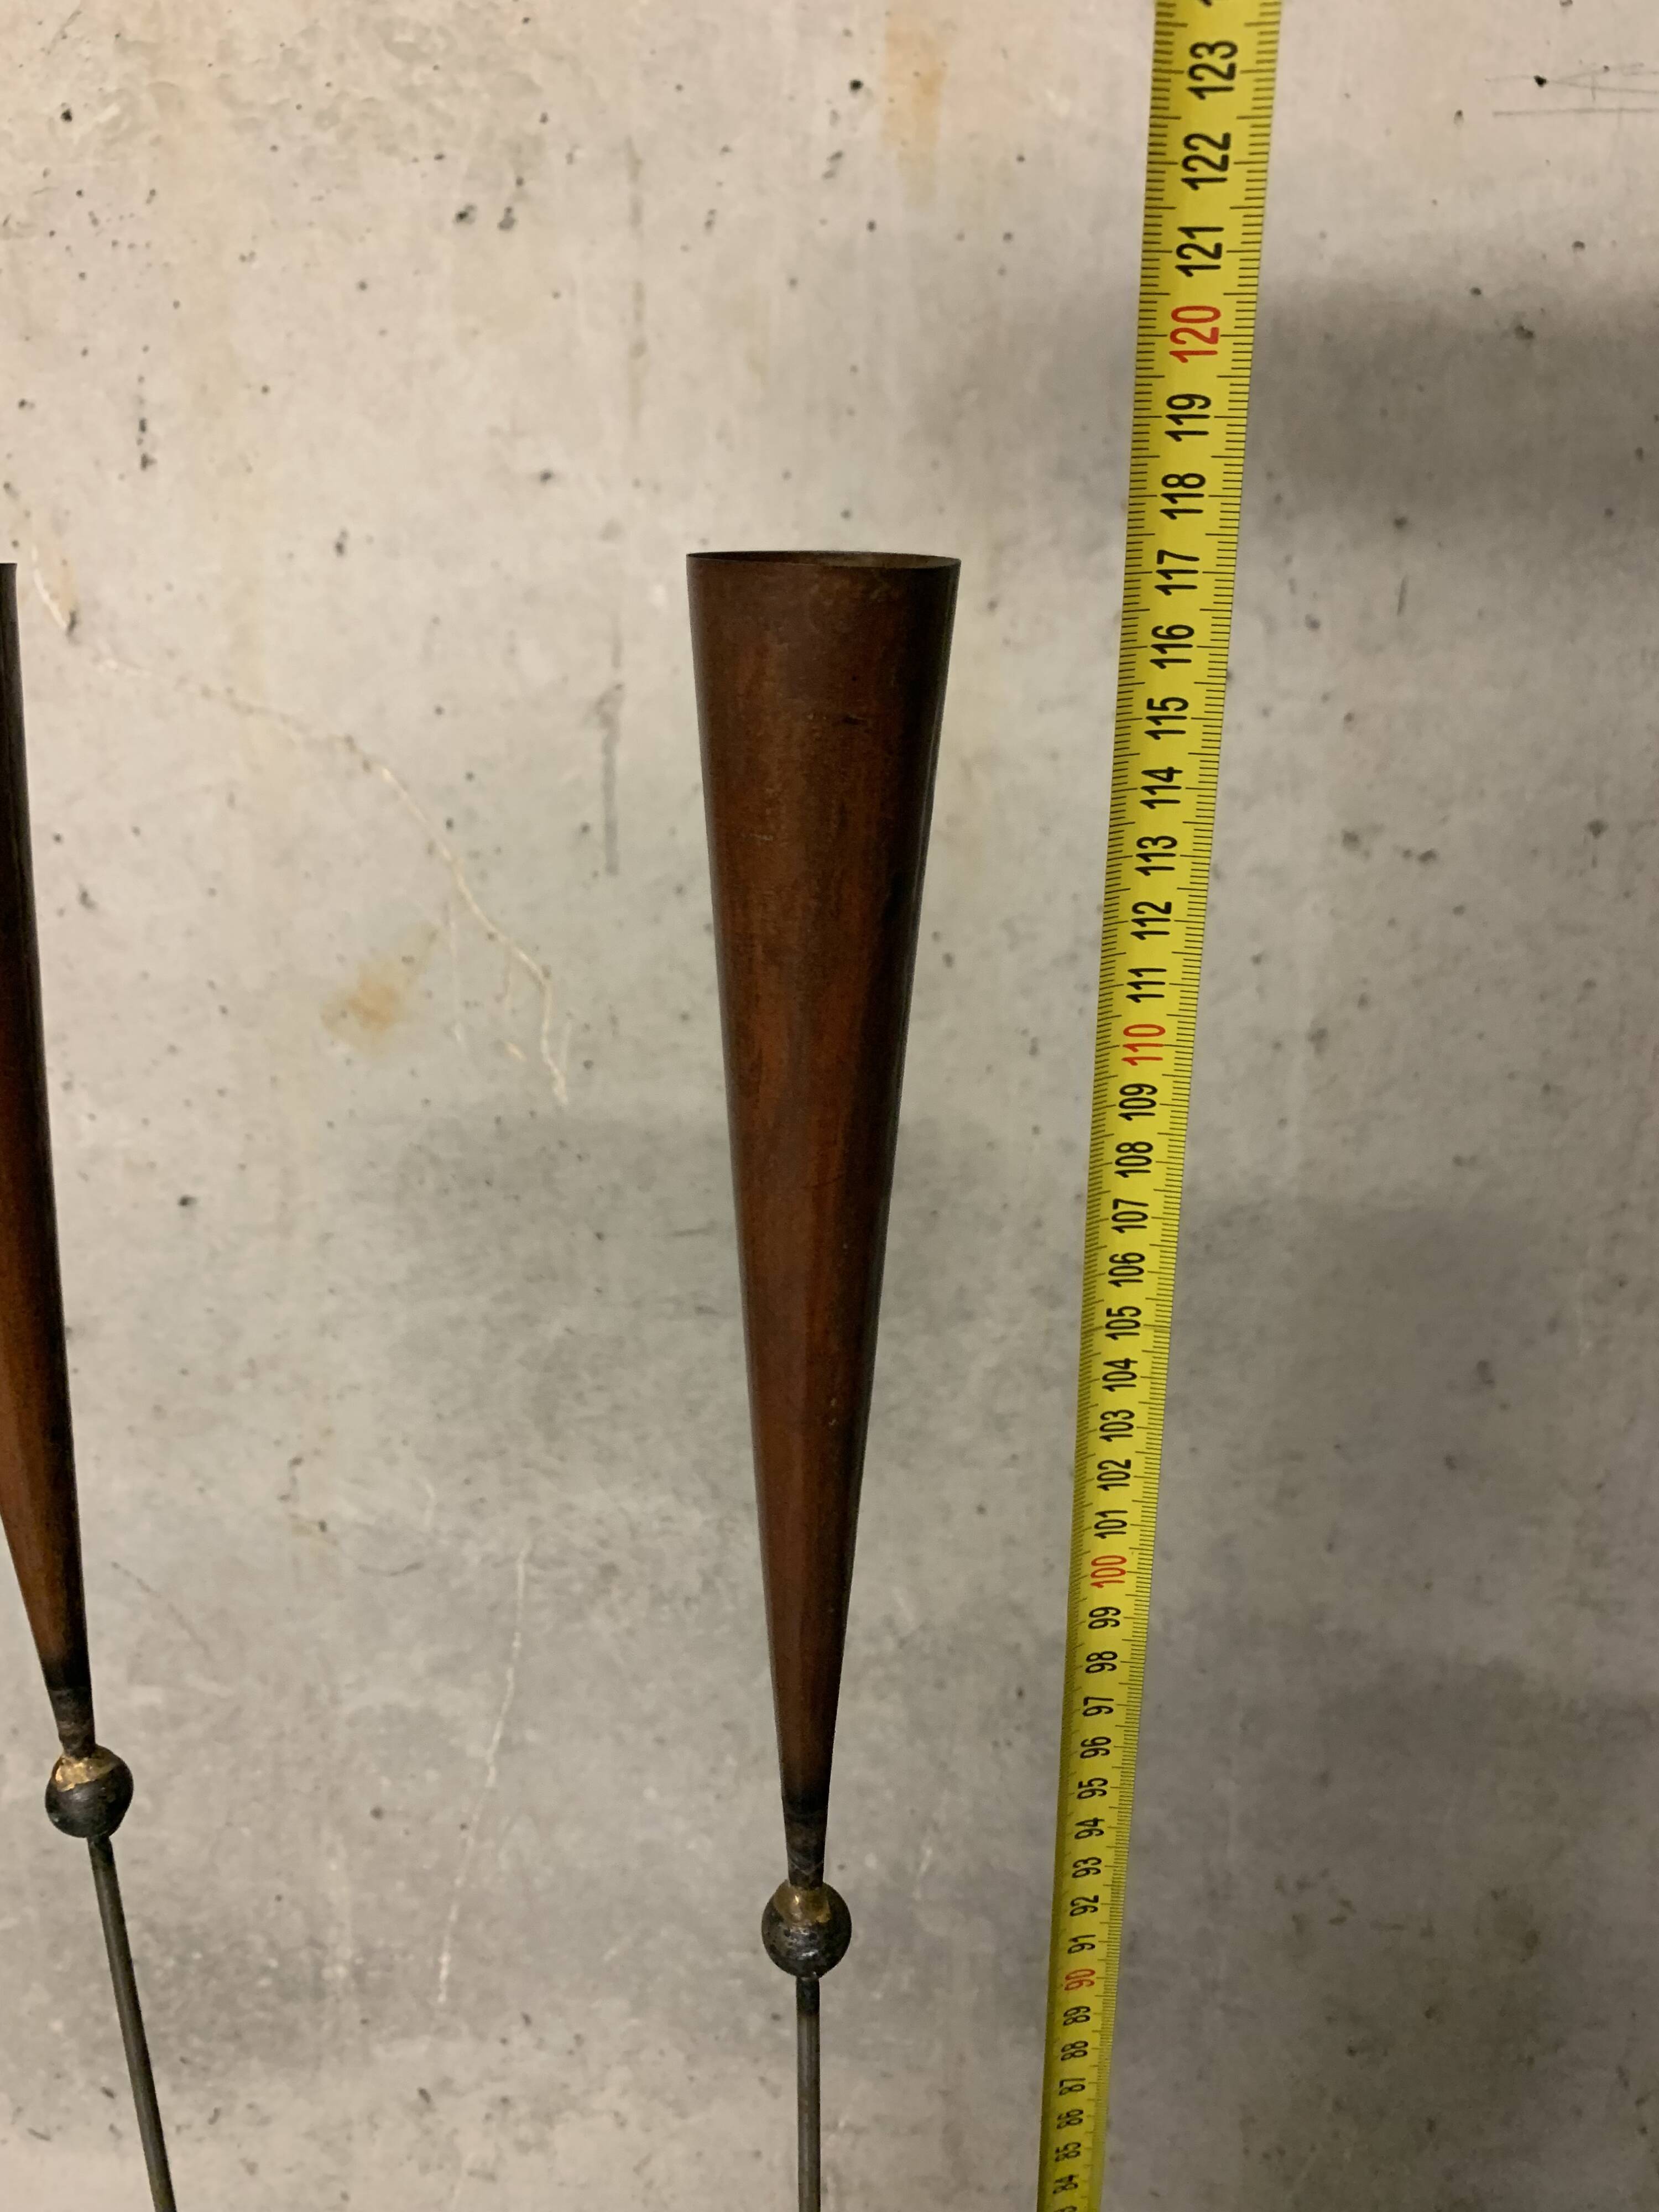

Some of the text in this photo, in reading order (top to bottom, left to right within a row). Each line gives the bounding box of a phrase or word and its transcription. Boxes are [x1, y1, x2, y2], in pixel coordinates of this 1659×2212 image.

[1186, 41, 1238, 100] 123
[1181, 133, 1231, 190] 122
[1175, 227, 1224, 277] 121
[1169, 306, 1221, 363] 120
[1164, 394, 1211, 442] 119
[1159, 473, 1206, 520] 118
[1154, 550, 1199, 596] 117
[1149, 624, 1194, 669] 116
[1144, 697, 1188, 740] 115
[1140, 766, 1183, 809] 114
[1134, 836, 1177, 876] 113
[1130, 901, 1172, 940] 112
[1125, 968, 1167, 1003] 111
[1121, 1024, 1166, 1066] 110
[1118, 1083, 1157, 1121] 109
[1114, 1141, 1153, 1178] 108
[1111, 1198, 1149, 1233] 107
[1108, 1253, 1145, 1287] 106
[1105, 1306, 1141, 1340] 105
[1102, 1358, 1138, 1392] 104
[1099, 1410, 1135, 1442] 103
[1097, 1459, 1131, 1491] 102
[1094, 1510, 1128, 1539] 101
[1090, 1556, 1126, 1588] 100
[1088, 1606, 1121, 1629] 99
[1085, 1651, 1118, 1674] 98
[1082, 1696, 1114, 1717] 97
[1079, 1736, 1112, 1759] 96
[1077, 1778, 1108, 1800] 95
[1075, 1817, 1104, 1840] 94
[1072, 1857, 1102, 1879] 93
[1070, 1895, 1099, 1917] 92
[1068, 1935, 1096, 1954] 91
[1065, 1969, 1095, 1991] 90
[1063, 2006, 1091, 2026] 89
[1061, 2041, 1088, 2061] 88
[1059, 2078, 1086, 2095] 87
